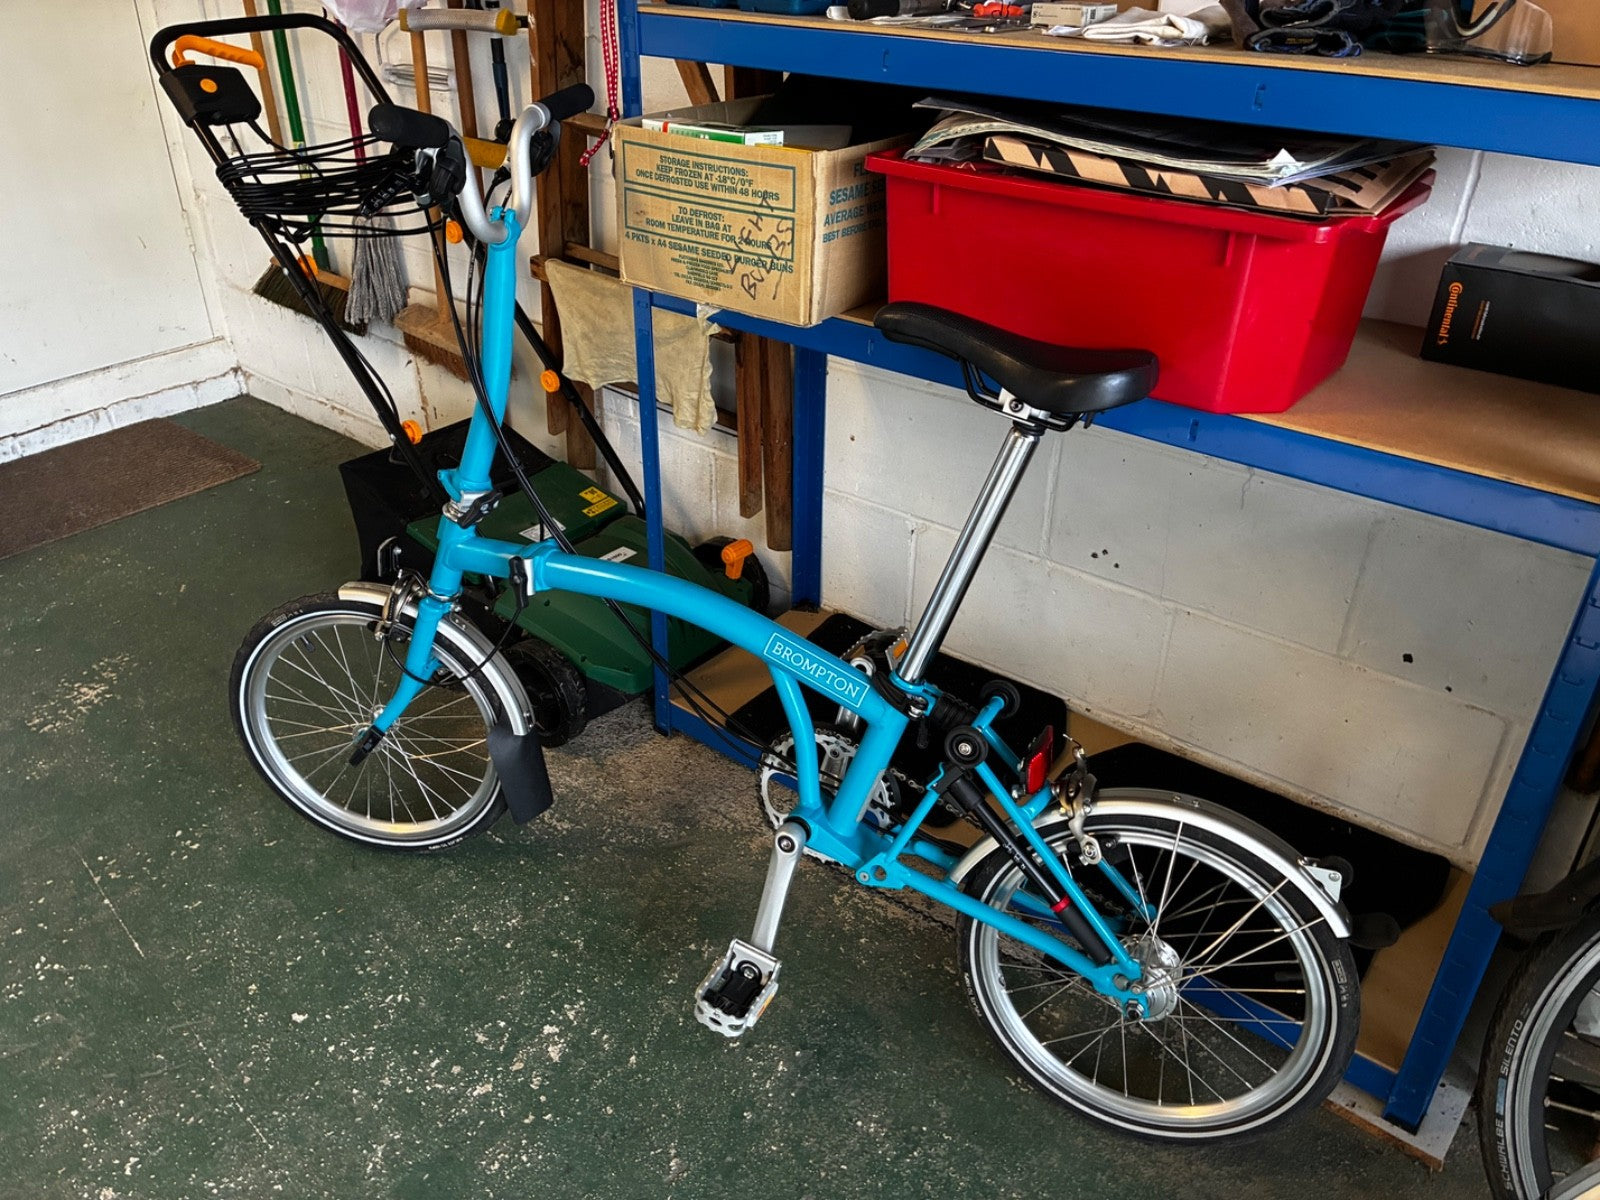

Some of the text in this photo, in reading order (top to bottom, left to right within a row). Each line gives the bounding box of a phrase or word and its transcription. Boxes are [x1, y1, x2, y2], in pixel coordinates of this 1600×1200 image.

[656, 164, 673, 175] KEEP
[674, 167, 703, 180] FROZEN
[703, 171, 714, 182] AT
[659, 154, 749, 178] STORAGE INSTRUCTIONS:
[635, 168, 780, 202] ONCE DEFROSTED USE WITHIN 48 HOURS
[829, 182, 870, 206] SESAME
[671, 214, 732, 233] LEAVE IN BAG AT
[678, 205, 725, 223] TO DEFROST:
[823, 205, 865, 227] AVERAGE
[645, 217, 666, 229] ROOM
[667, 222, 720, 241] TEMPERATURE
[721, 233, 736, 244] FOR
[822, 230, 840, 244] BEST
[841, 222, 867, 238] BEFORE
[625, 231, 631, 240] 4
[631, 232, 650, 245] PKTS
[668, 240, 700, 255] SESAME
[701, 247, 732, 262] SEEDED
[734, 253, 771, 271] BURGER
[771, 260, 793, 274] BUNS
[1439, 281, 1464, 338] Continental
[772, 641, 860, 699] BROMPTON
[1500, 1019, 1524, 1077] SILENTO
[1495, 1119, 1515, 1192] SCHWALBE
